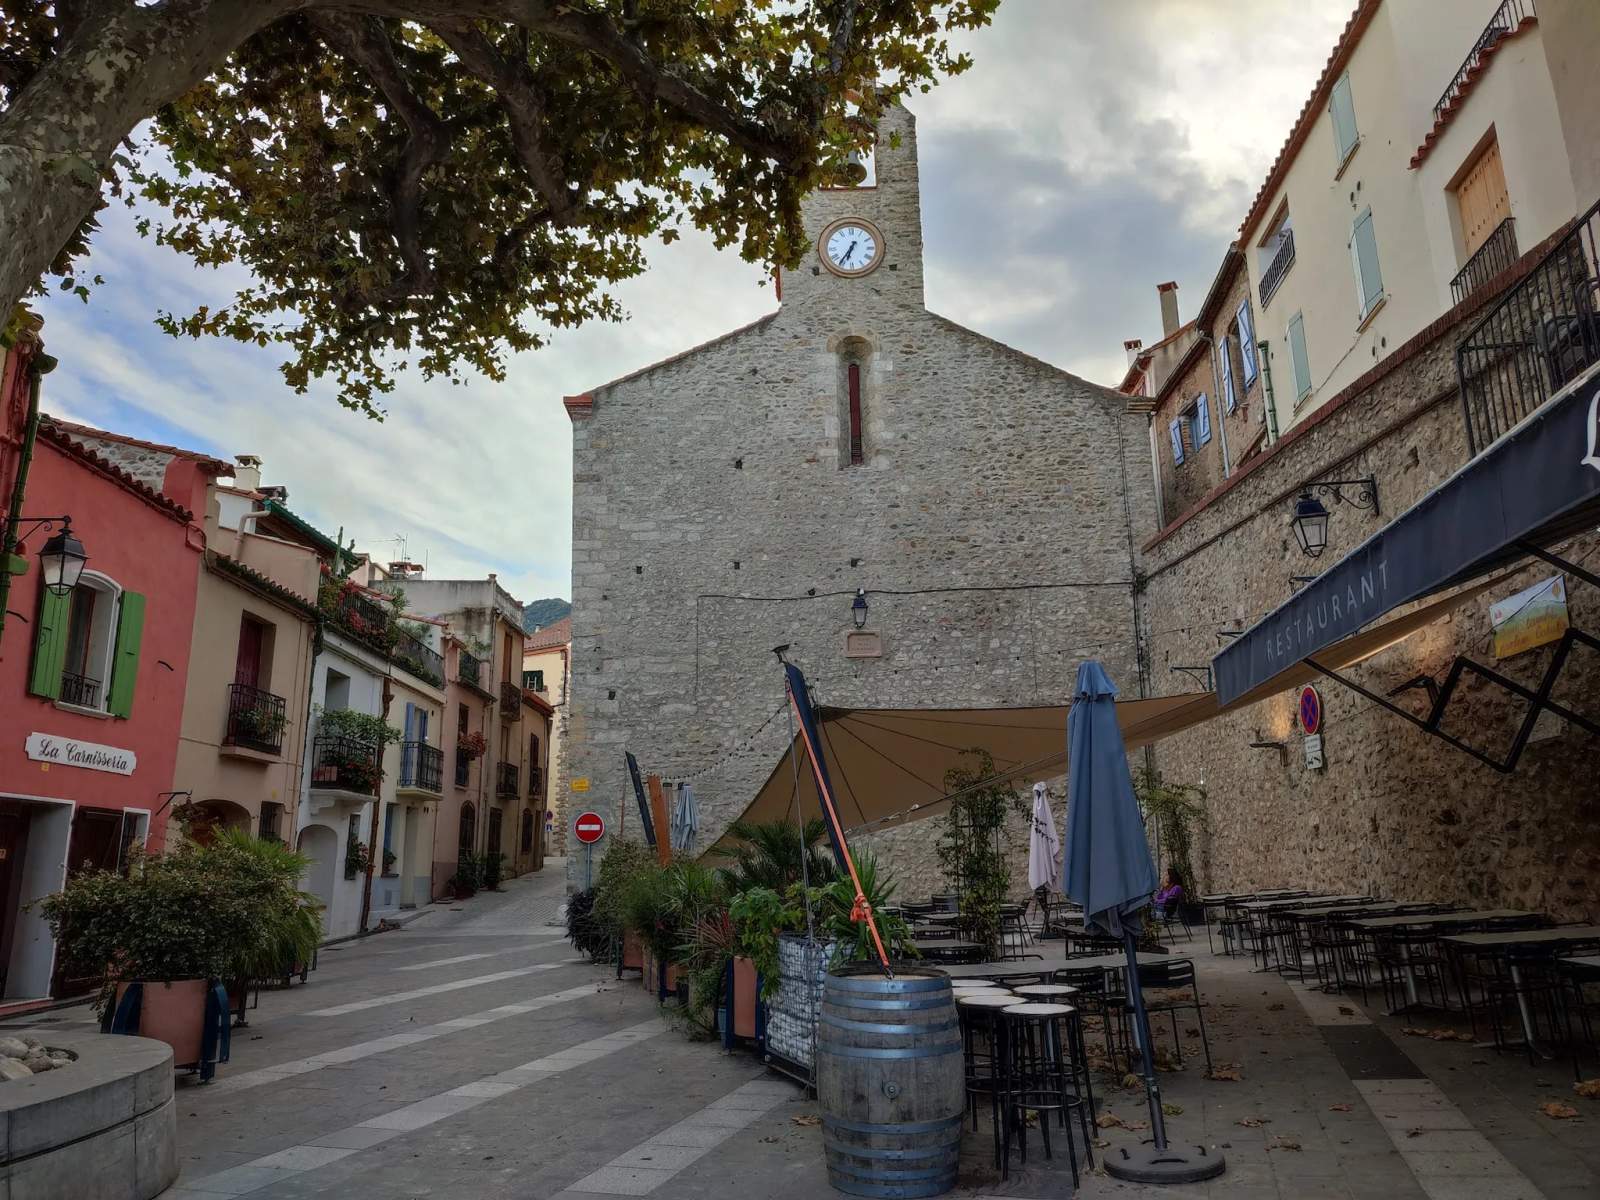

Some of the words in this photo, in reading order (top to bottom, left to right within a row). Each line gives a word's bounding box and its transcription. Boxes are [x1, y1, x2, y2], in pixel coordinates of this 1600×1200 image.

[1266, 560, 1388, 662] RESTAURANT
[39, 739, 59, 759] La
[66, 743, 128, 770] Carnisseria
